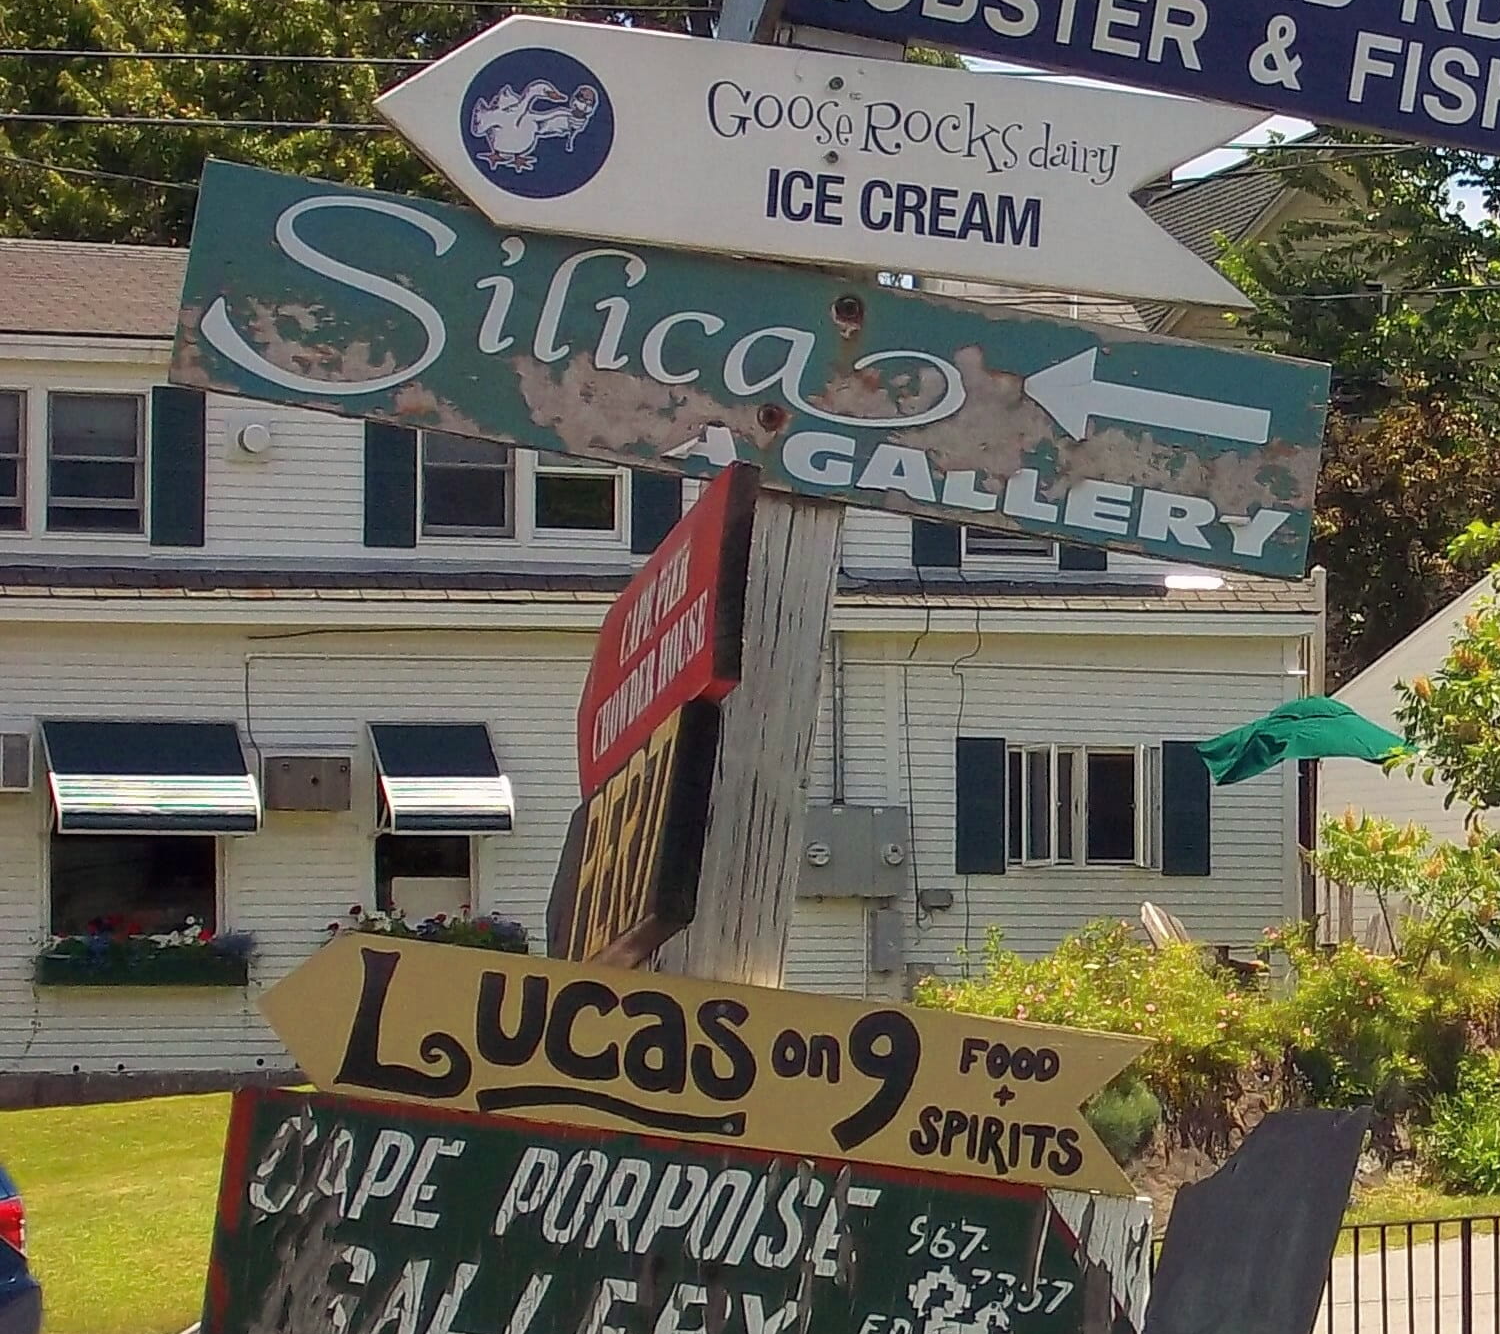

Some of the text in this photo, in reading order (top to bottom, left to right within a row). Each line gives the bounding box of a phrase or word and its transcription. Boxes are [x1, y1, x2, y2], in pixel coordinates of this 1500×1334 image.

[1248, 14, 1303, 91] &
[1028, 123, 1121, 186] dairy
[766, 167, 1042, 248] ICE CREAM
[200, 193, 966, 427] Silica
[781, 430, 1291, 558] GALLERY
[591, 588, 709, 764] CHOWDER HOUSE
[771, 1026, 841, 1083] on
[830, 1009, 922, 1152] 9
[959, 1037, 1061, 1083] FOOD
[909, 1104, 1084, 1177] SPIRITS
[247, 1113, 883, 1277] CAPE PORPOISE
